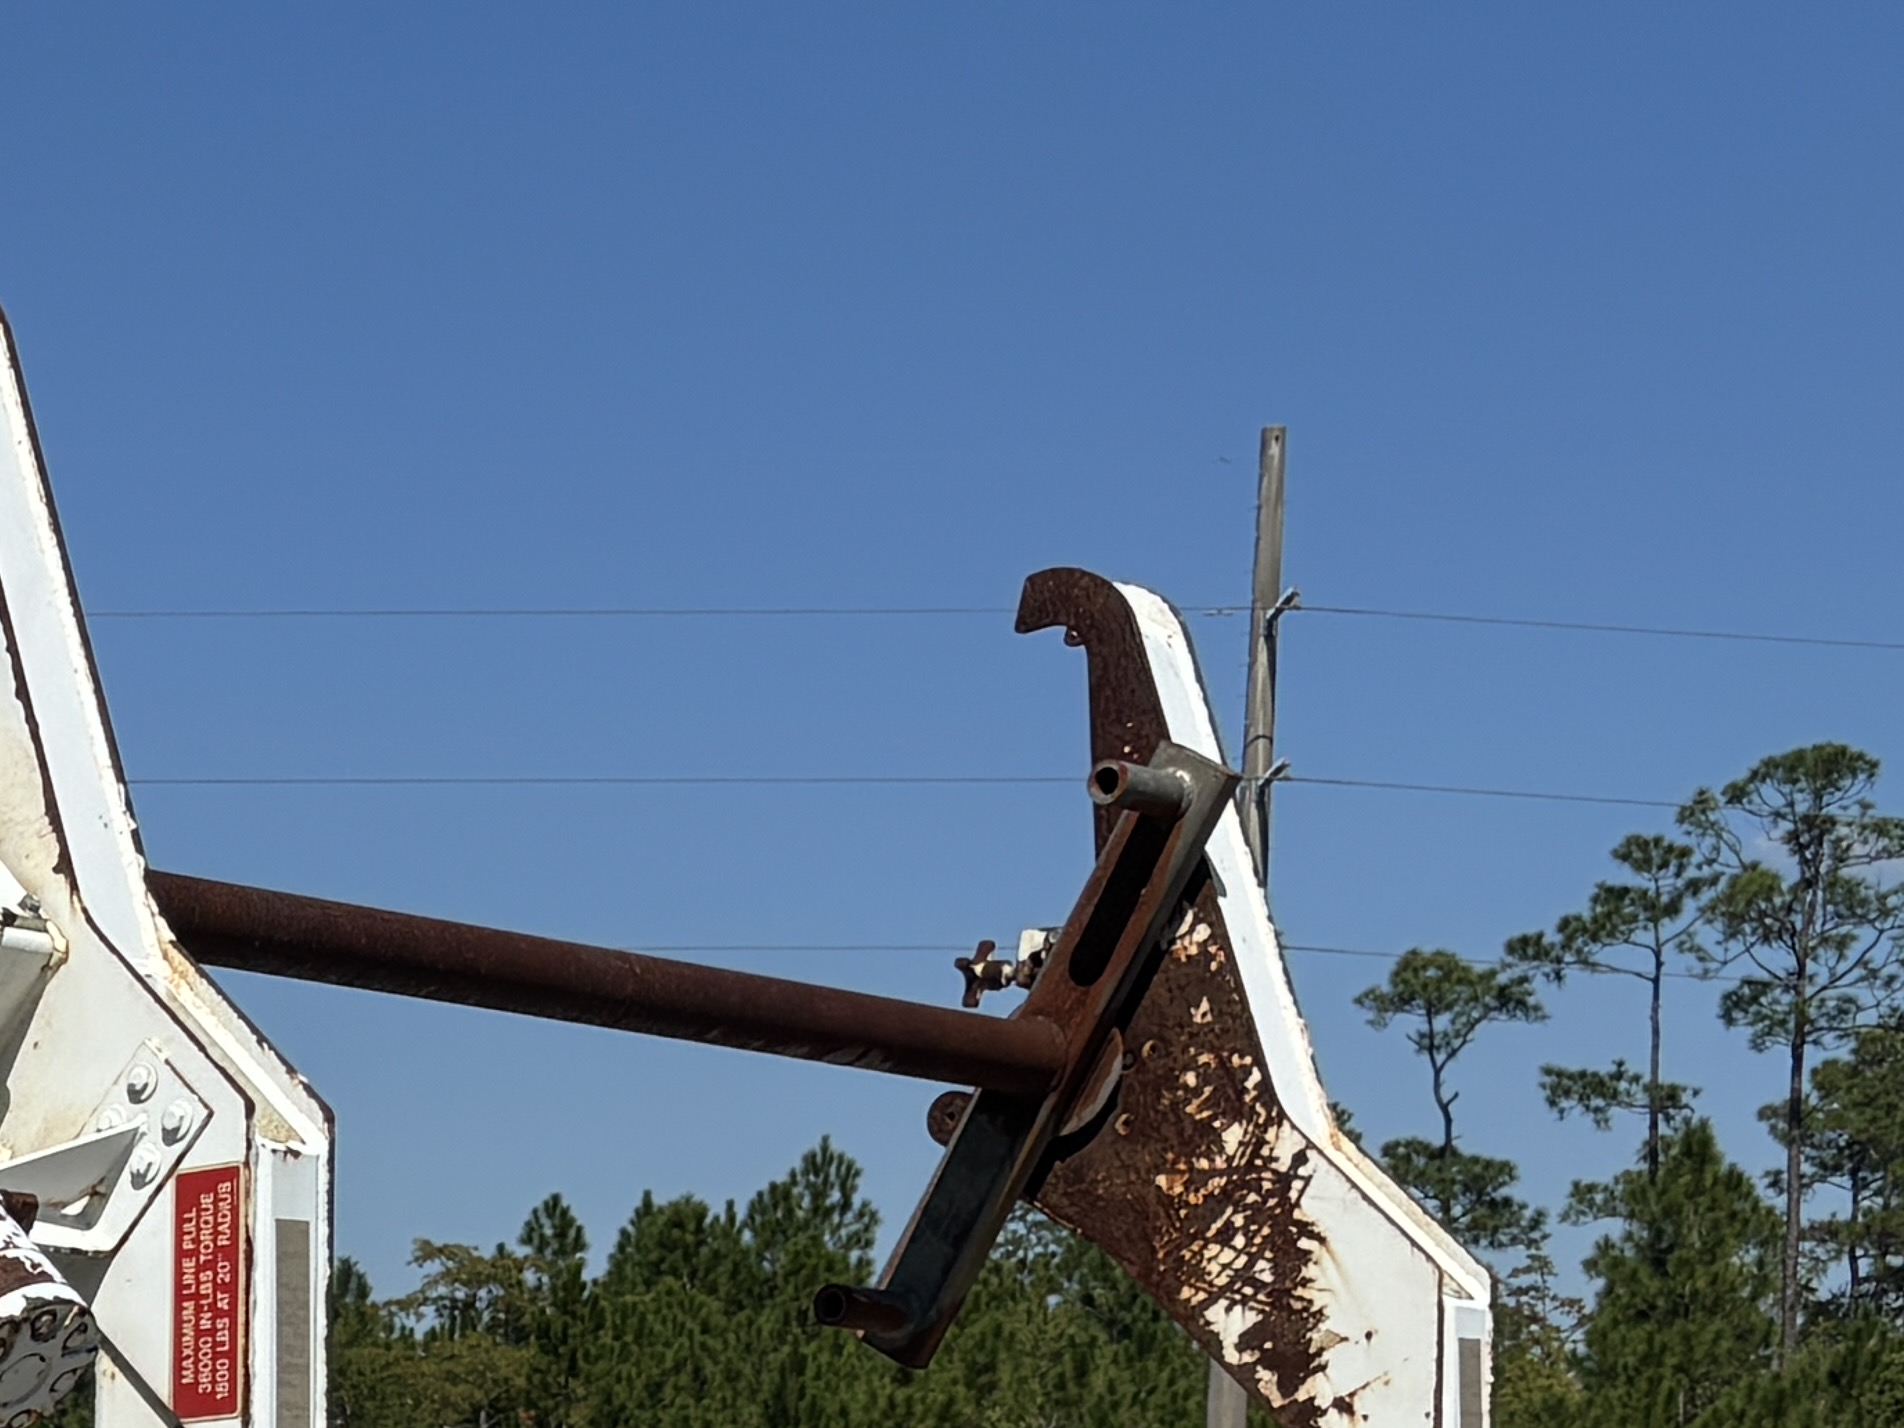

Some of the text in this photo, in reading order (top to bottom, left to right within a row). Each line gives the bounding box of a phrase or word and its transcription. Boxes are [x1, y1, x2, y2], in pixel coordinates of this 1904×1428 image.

[200, 1192, 214, 1264] TORQUE
[217, 1181, 232, 1246] RADIUS
[181, 1207, 196, 1384] MAXIMUM LINE PULL
[217, 1292, 230, 1310] AT
[216, 1317, 230, 1352] LBS
